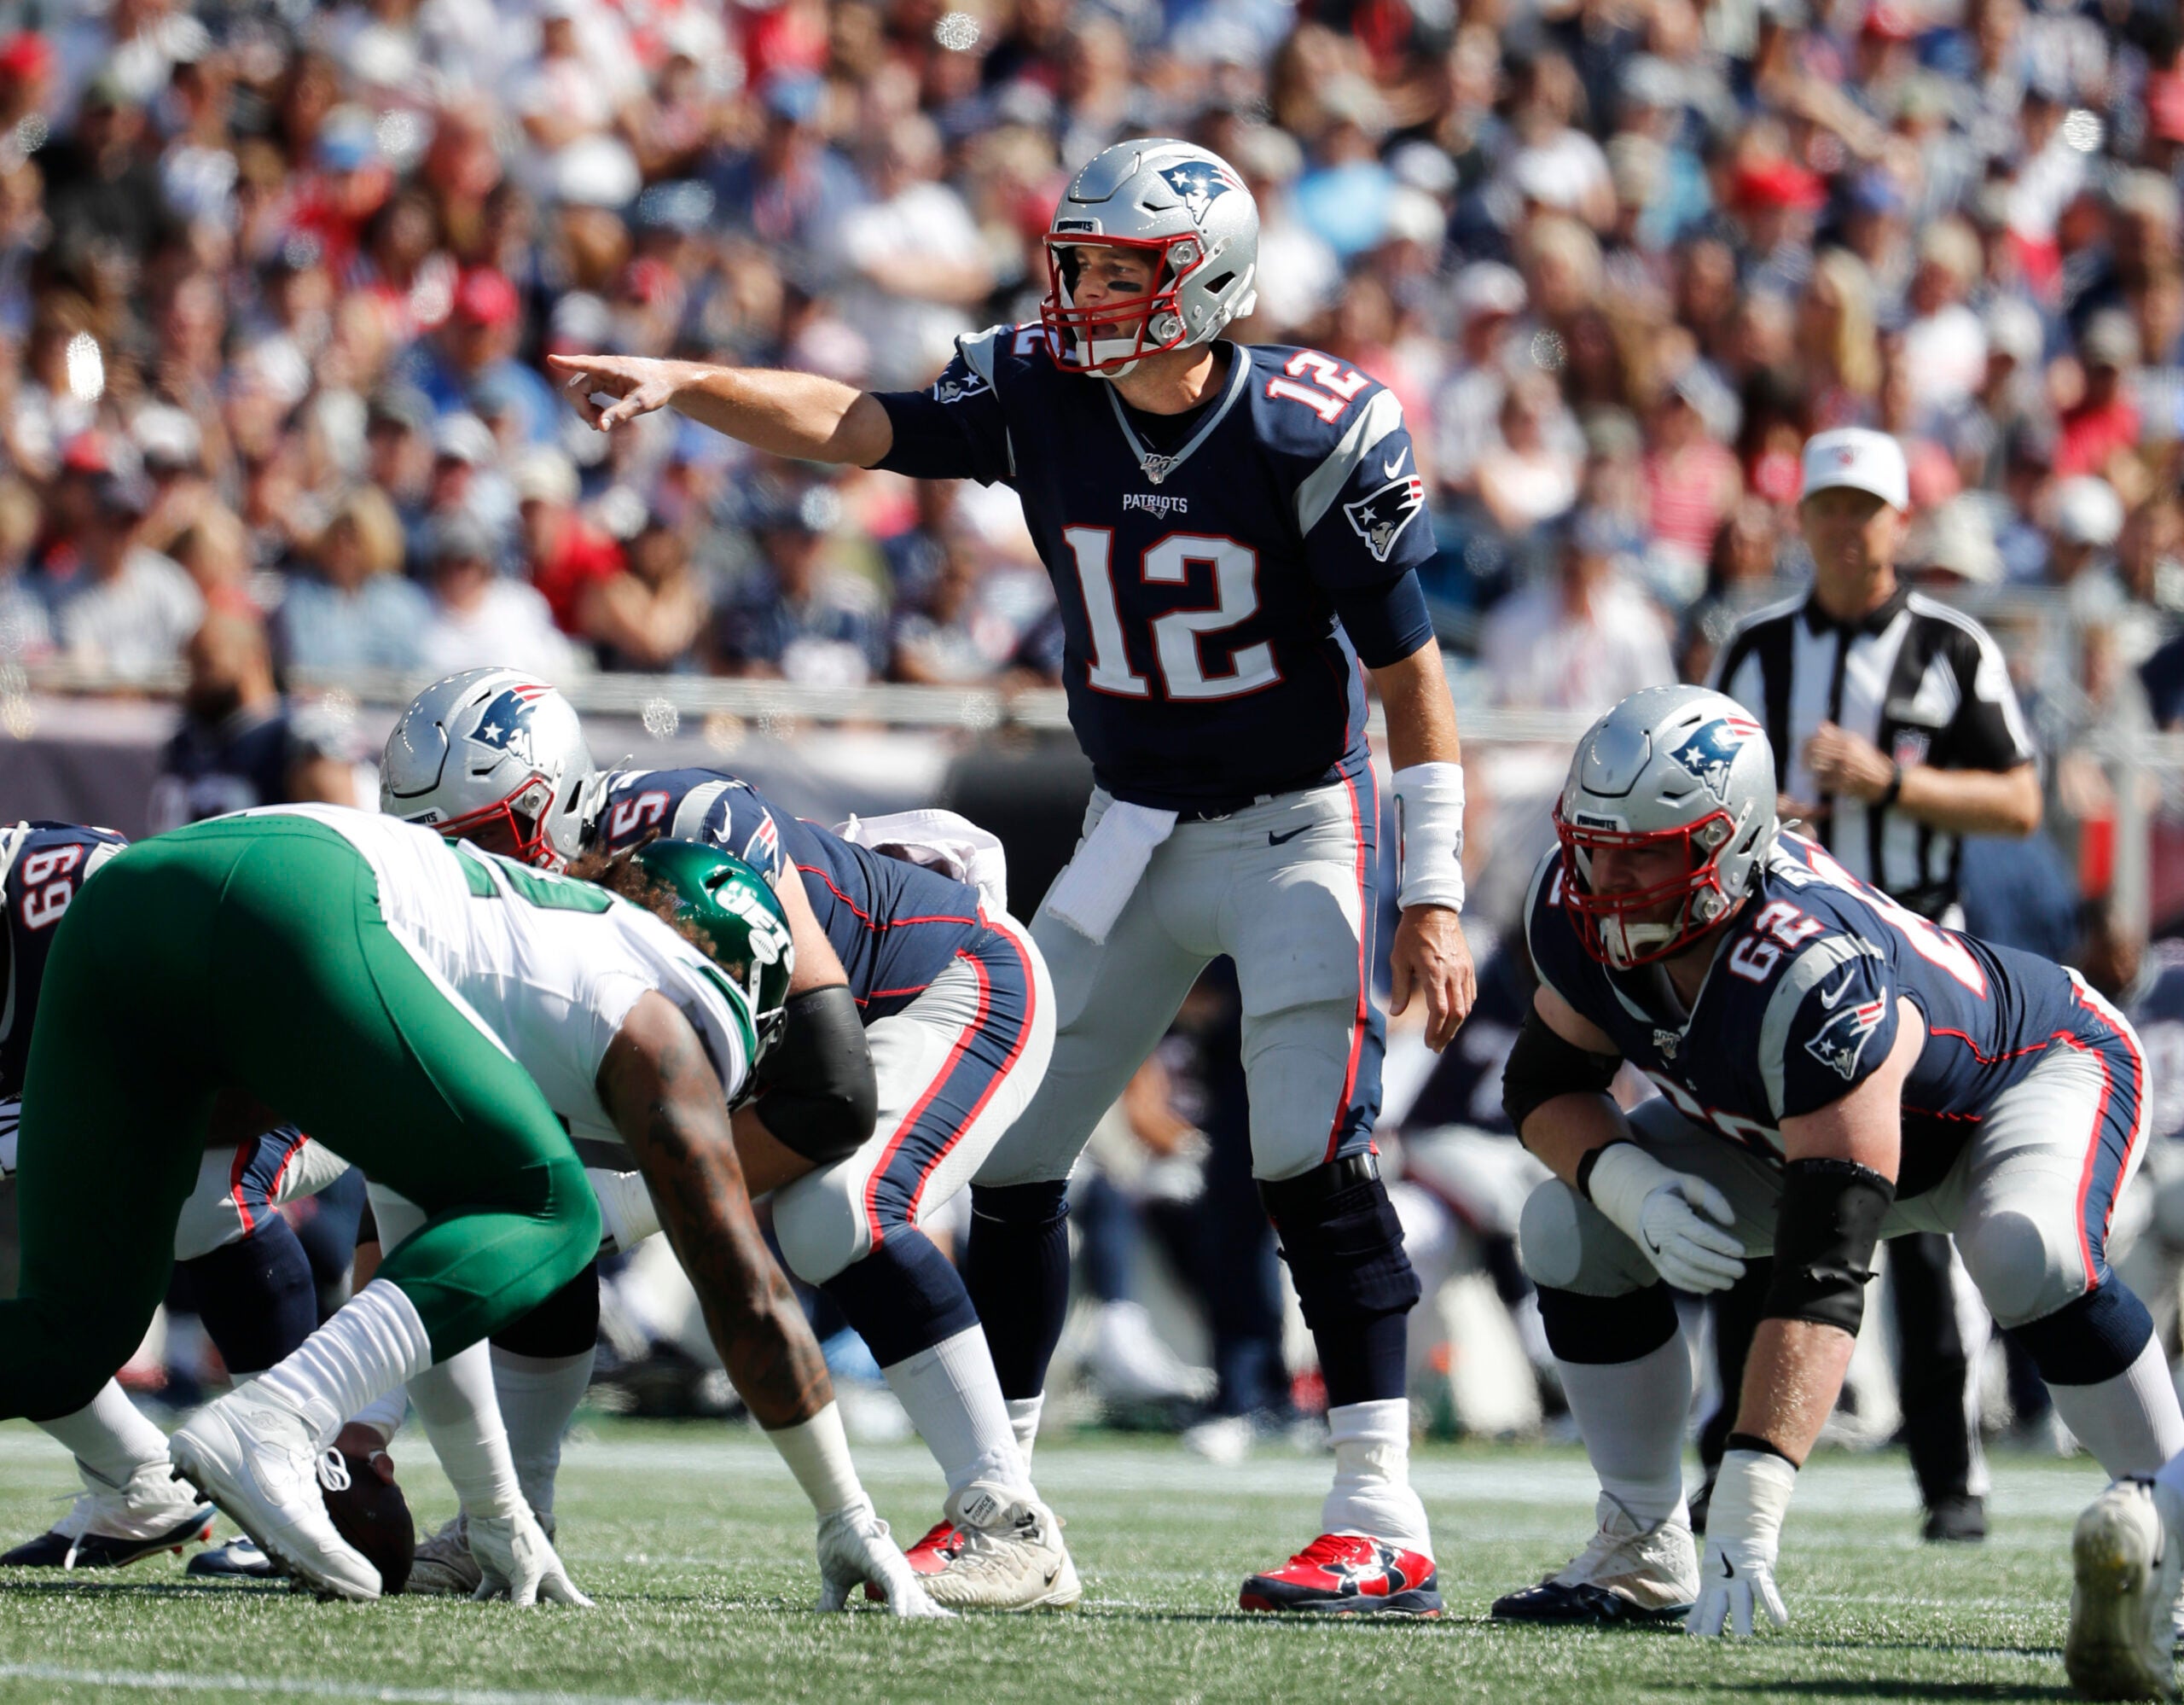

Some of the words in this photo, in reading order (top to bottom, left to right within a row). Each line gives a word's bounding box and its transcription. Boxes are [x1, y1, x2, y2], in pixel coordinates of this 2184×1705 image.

[1266, 348, 1372, 425] 12
[1123, 493, 1188, 513] PATRIOTS
[1061, 523, 1286, 702] 12
[21, 842, 84, 932] 69
[1727, 899, 1826, 986] 62
[971, 1494, 992, 1522] FORCE
